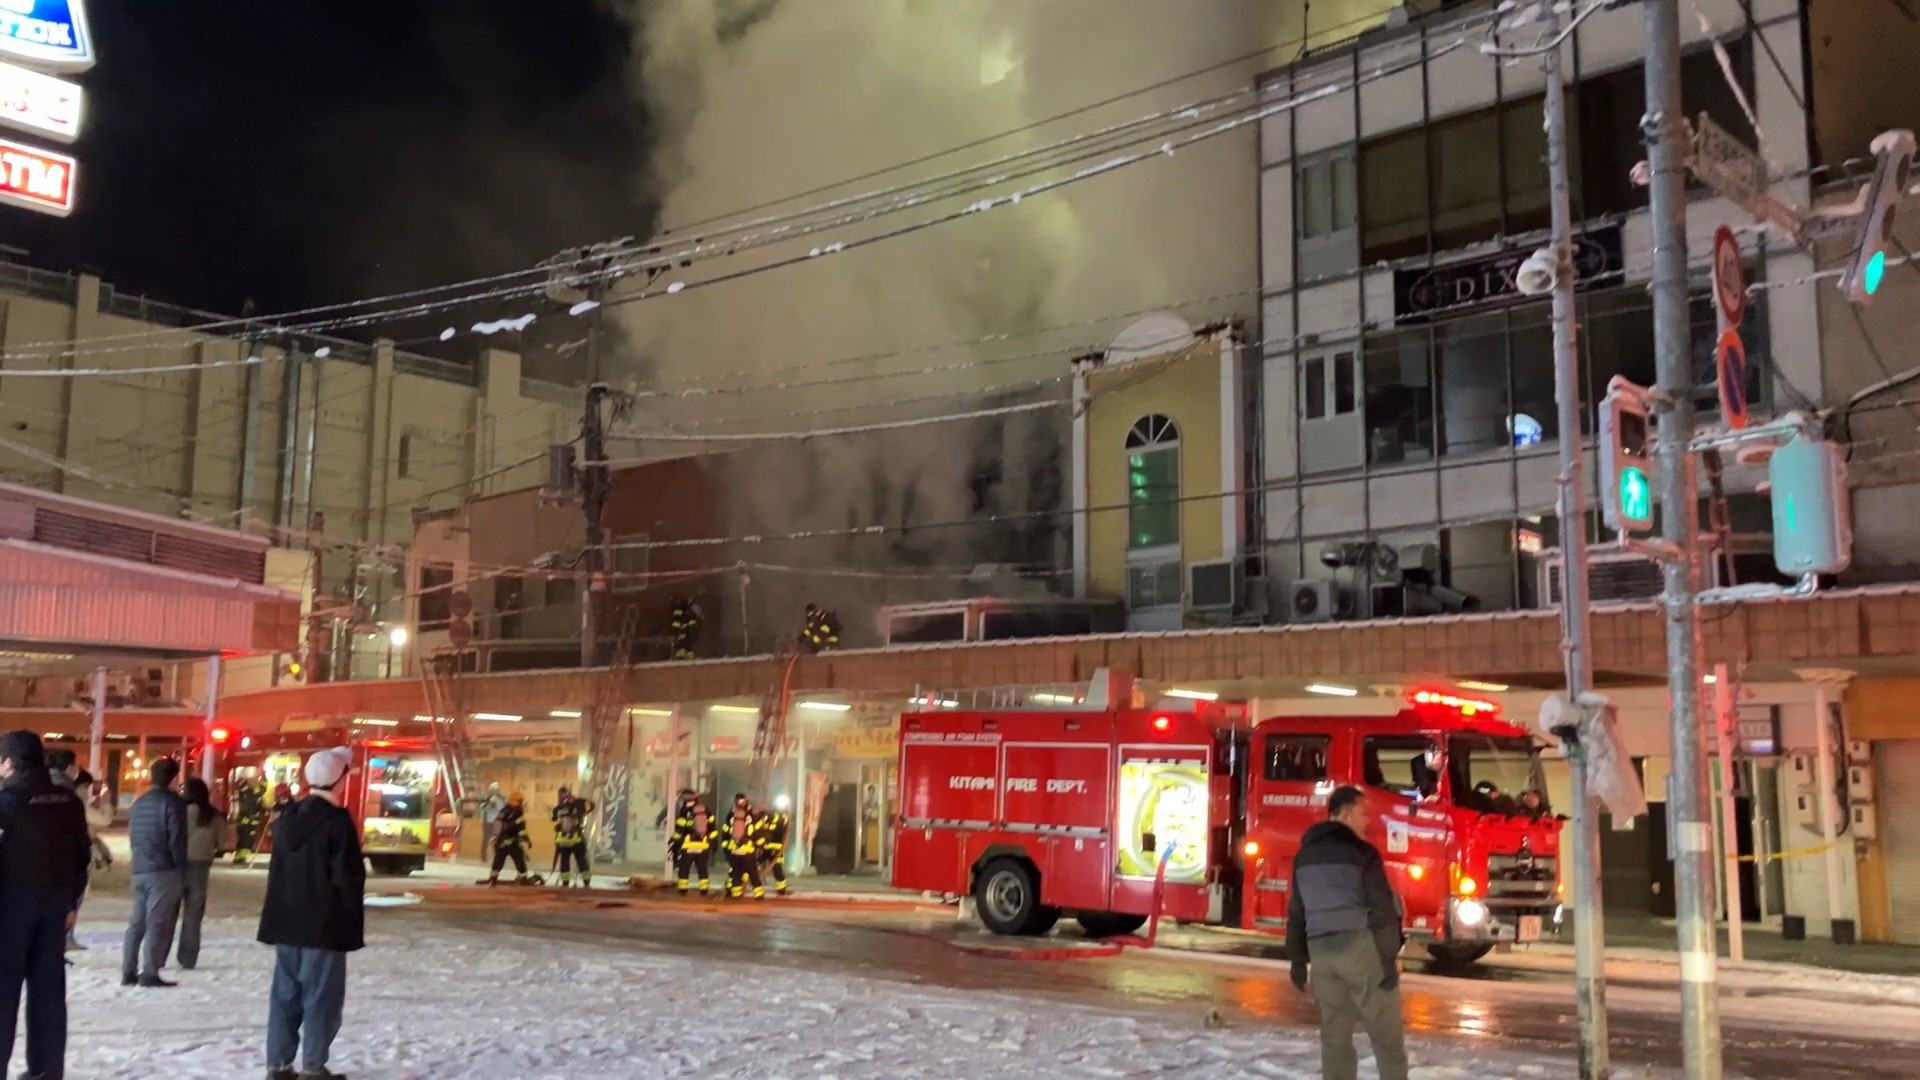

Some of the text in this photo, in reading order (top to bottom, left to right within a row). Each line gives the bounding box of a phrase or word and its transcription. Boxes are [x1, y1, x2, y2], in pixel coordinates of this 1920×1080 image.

[0, 7, 72, 45] TION
[949, 776, 1088, 794] KITAMI FIRE DEPT.
